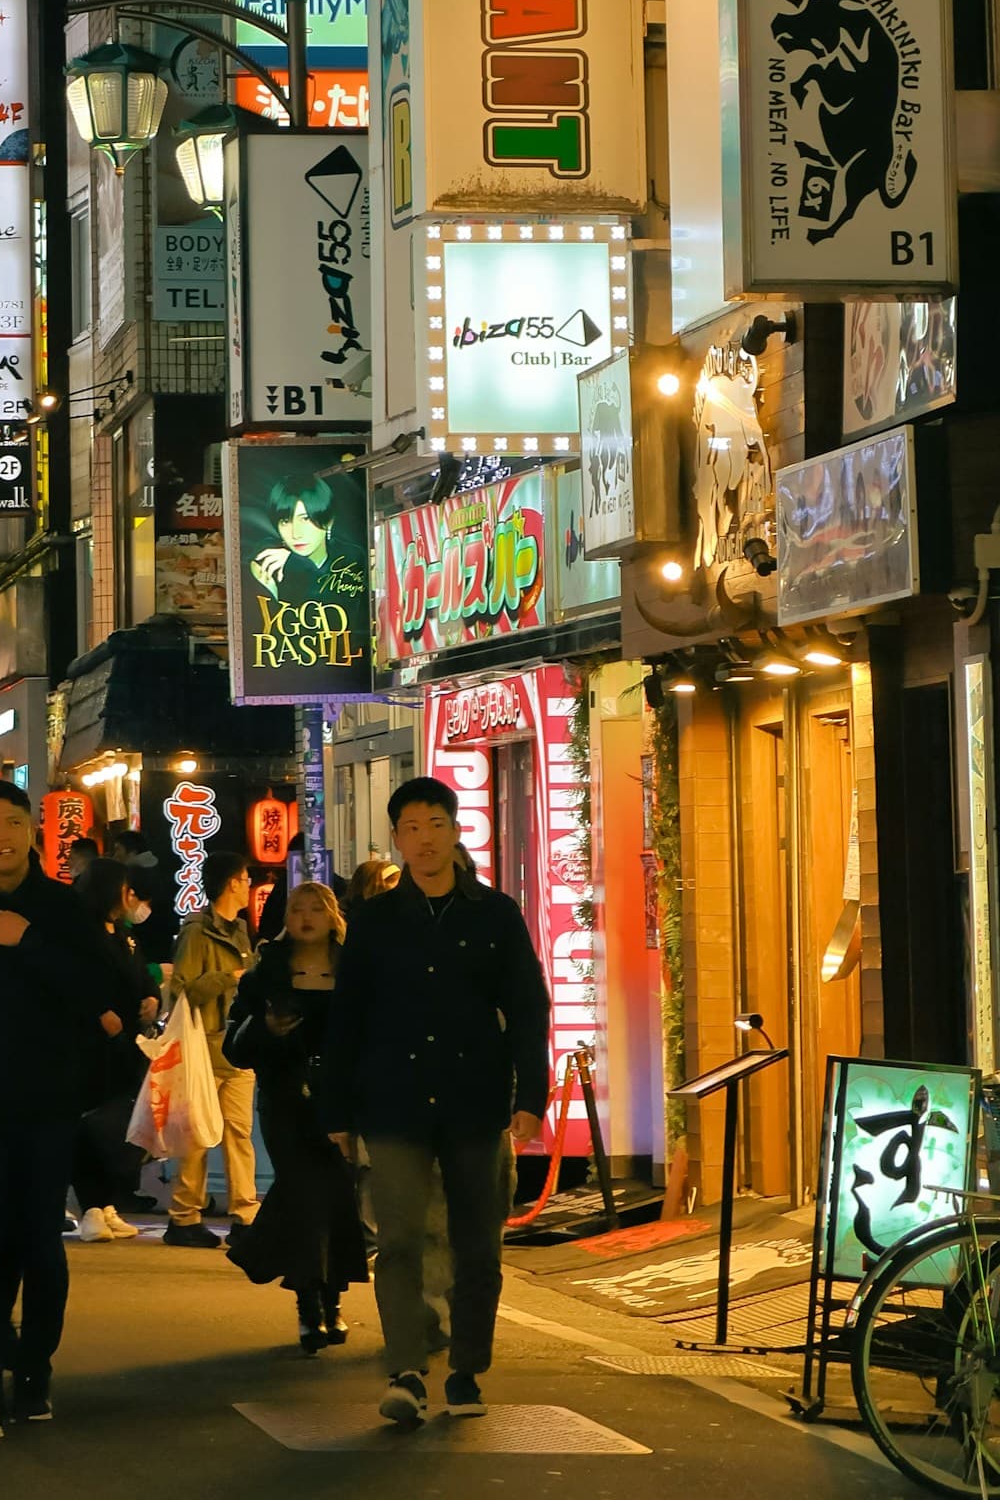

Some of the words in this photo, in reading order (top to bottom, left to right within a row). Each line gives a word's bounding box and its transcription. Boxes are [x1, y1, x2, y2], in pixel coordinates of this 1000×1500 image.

[768, 58, 785, 83] NO
[895, 100, 921, 141] Bar
[770, 162, 787, 187] NO
[165, 235, 224, 253] BODY
[890, 231, 934, 266] B1
[0, 315, 24, 329] 3F
[510, 351, 551, 366] Club
[561, 352, 593, 366] Bar
[283, 386, 323, 415] B1
[0, 459, 20, 476] 2F
[402, 513, 541, 634] ガールズバー
[256, 595, 349, 640] YGGD
